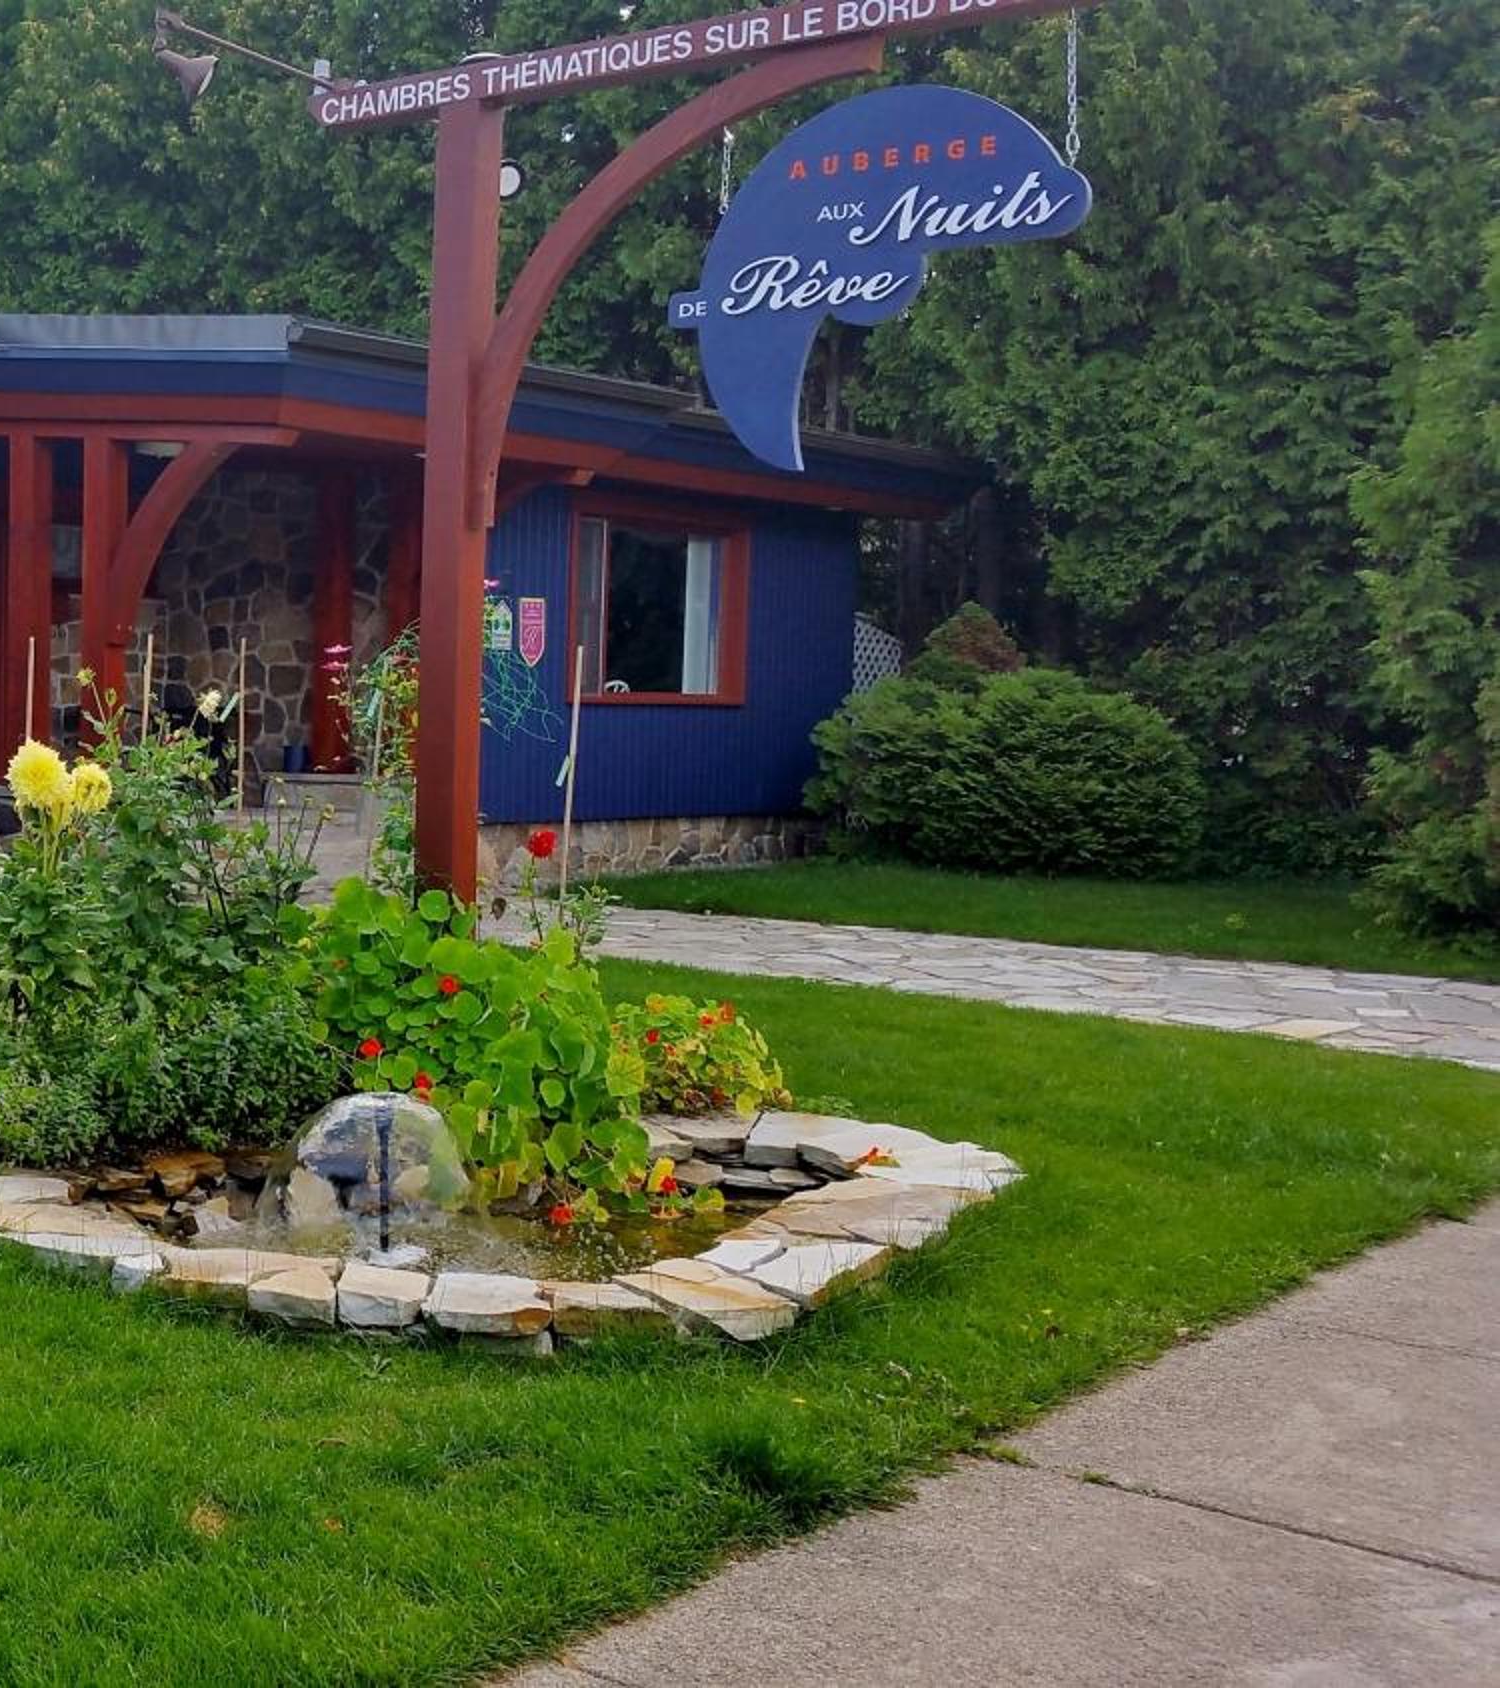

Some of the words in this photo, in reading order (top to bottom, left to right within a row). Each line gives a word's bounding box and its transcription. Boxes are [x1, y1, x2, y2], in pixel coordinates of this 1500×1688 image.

[321, 73, 471, 124] CHAMBRES
[482, 38, 692, 95] THÉMATIQUES
[705, 18, 769, 54] SUR
[783, 8, 823, 40] LE
[837, 0, 935, 31] BORD
[788, 135, 997, 180] AUBERGE
[816, 201, 865, 222] AUX
[849, 171, 1074, 246] Nuits
[678, 301, 707, 318] DE
[721, 255, 908, 315] Rêve
